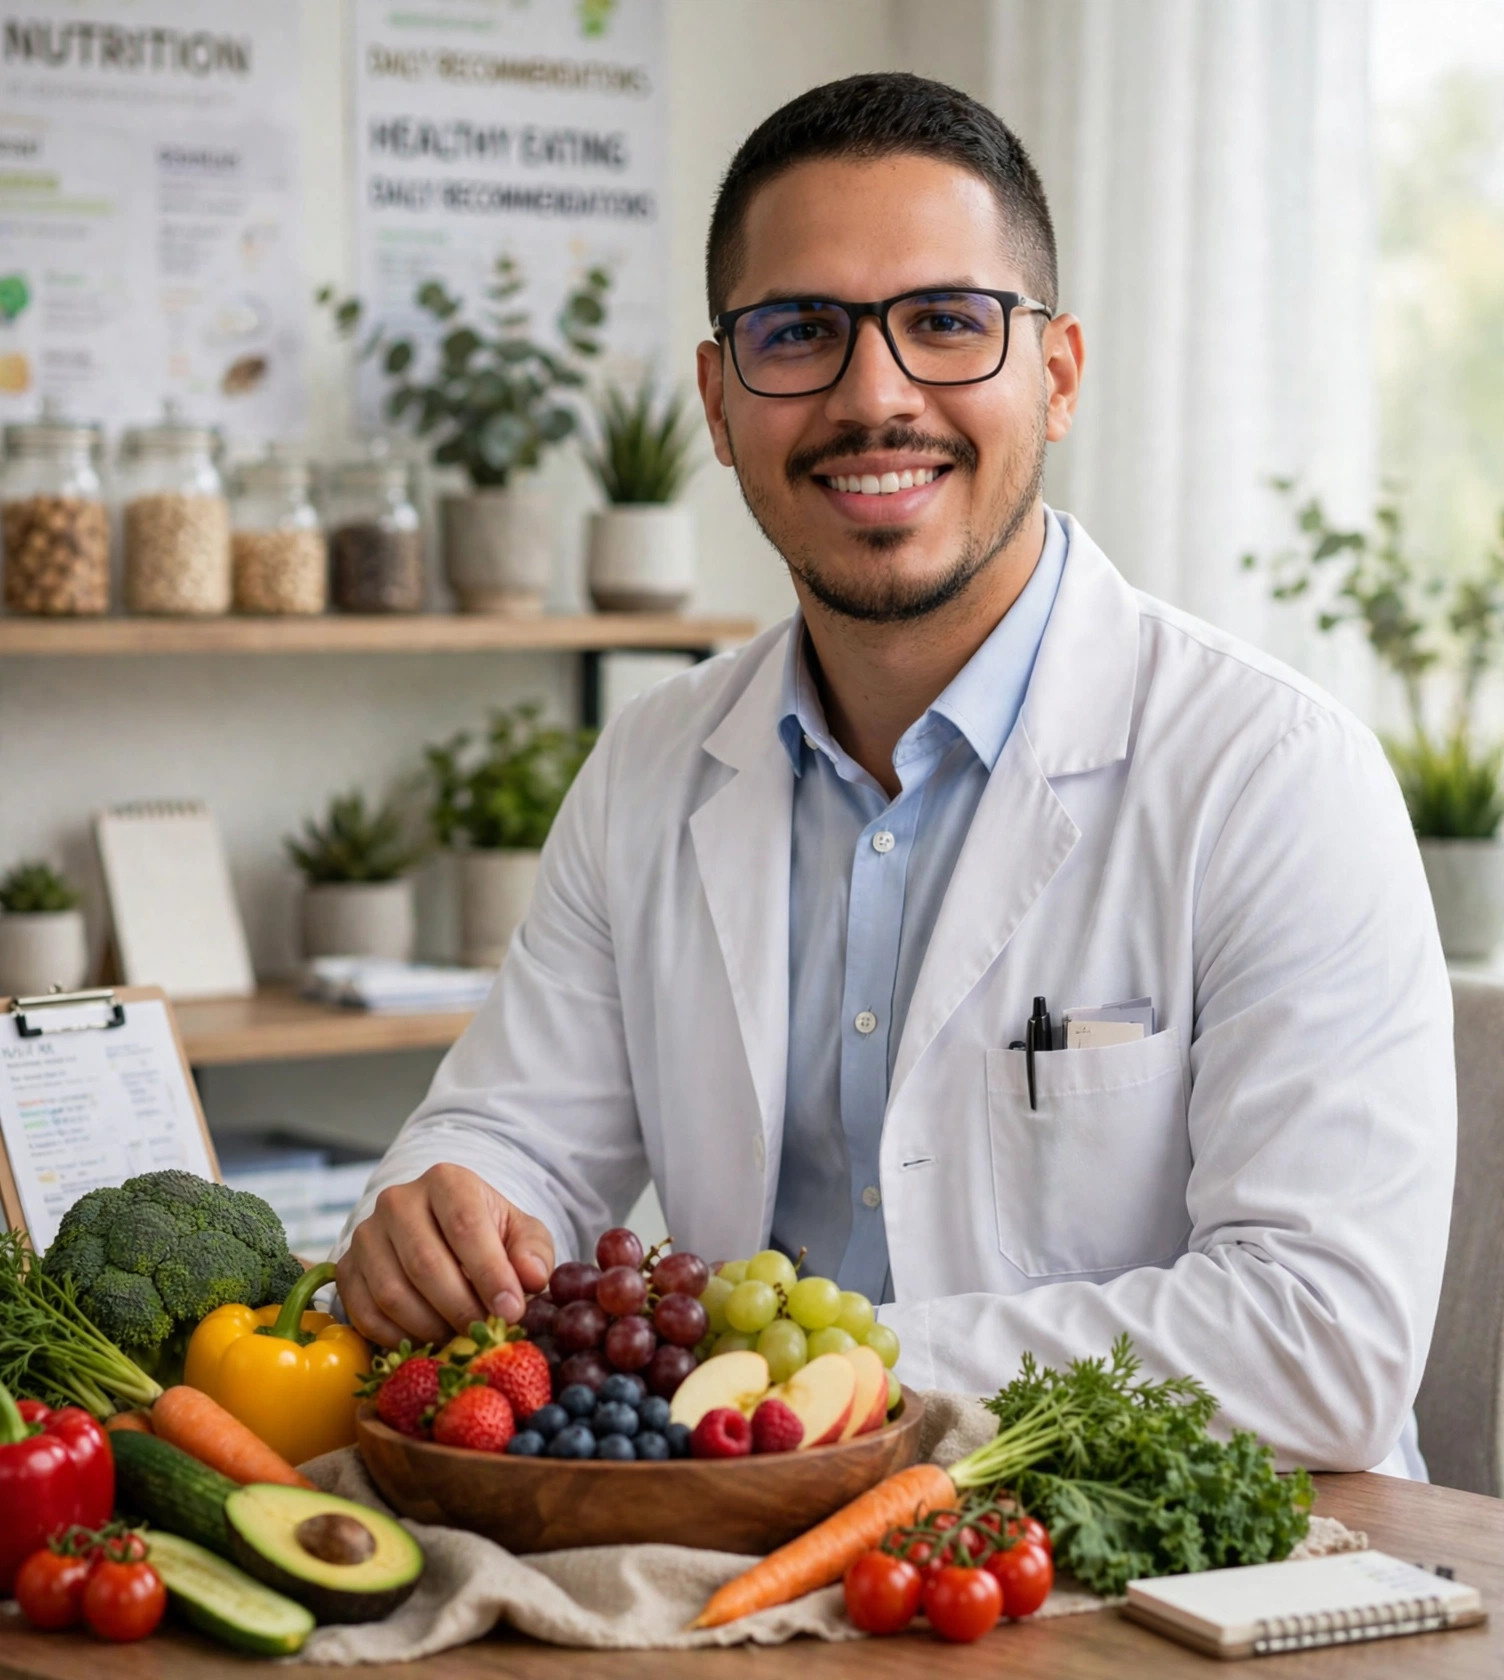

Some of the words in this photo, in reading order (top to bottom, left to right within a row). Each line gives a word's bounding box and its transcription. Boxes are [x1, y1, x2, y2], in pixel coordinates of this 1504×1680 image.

[5, 21, 250, 76] NUTRITION
[369, 119, 508, 161] HEALTHY
[521, 127, 626, 172] EATING
